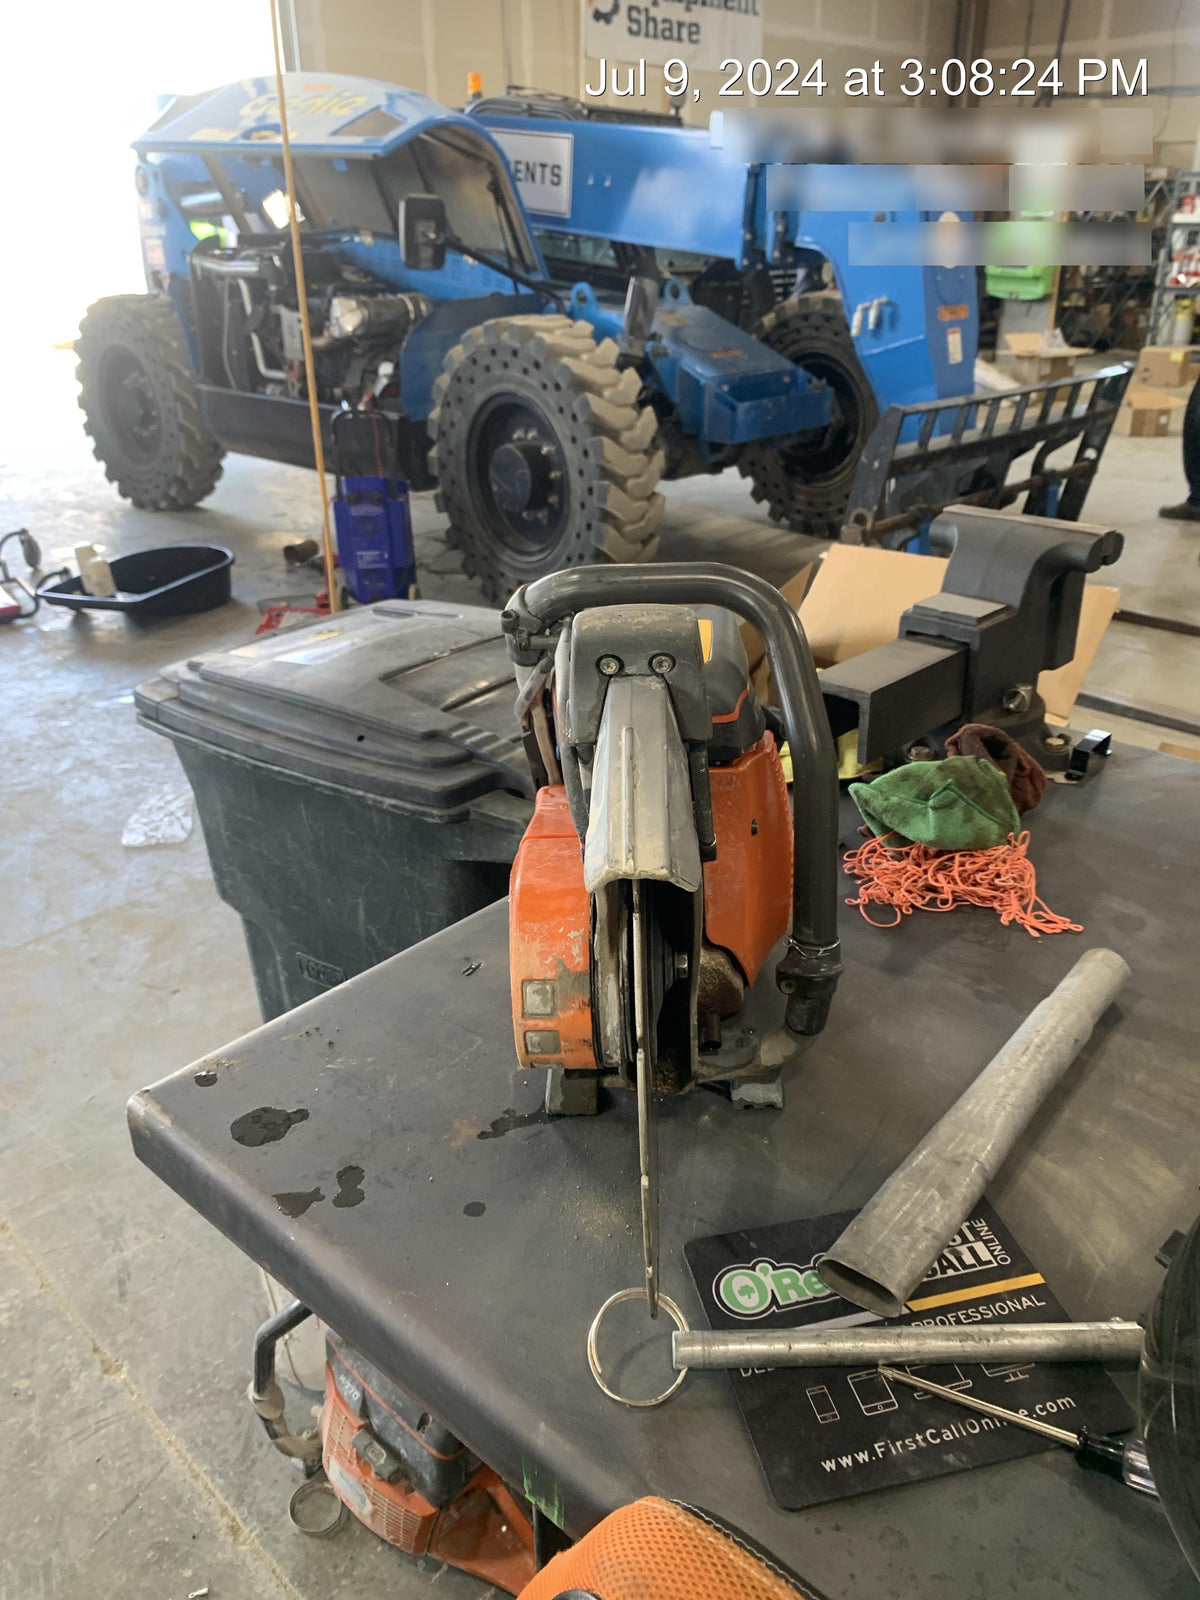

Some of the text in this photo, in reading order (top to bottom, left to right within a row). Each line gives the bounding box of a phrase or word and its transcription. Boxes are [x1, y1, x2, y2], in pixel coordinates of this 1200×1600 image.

[627, 4, 702, 45] Share
[514, 160, 563, 187] ENTS
[971, 1218, 1012, 1266] ONLINE
[721, 1263, 832, 1314] O'Re
[820, 1395, 1077, 1473] www.FirstCallOnle.com
